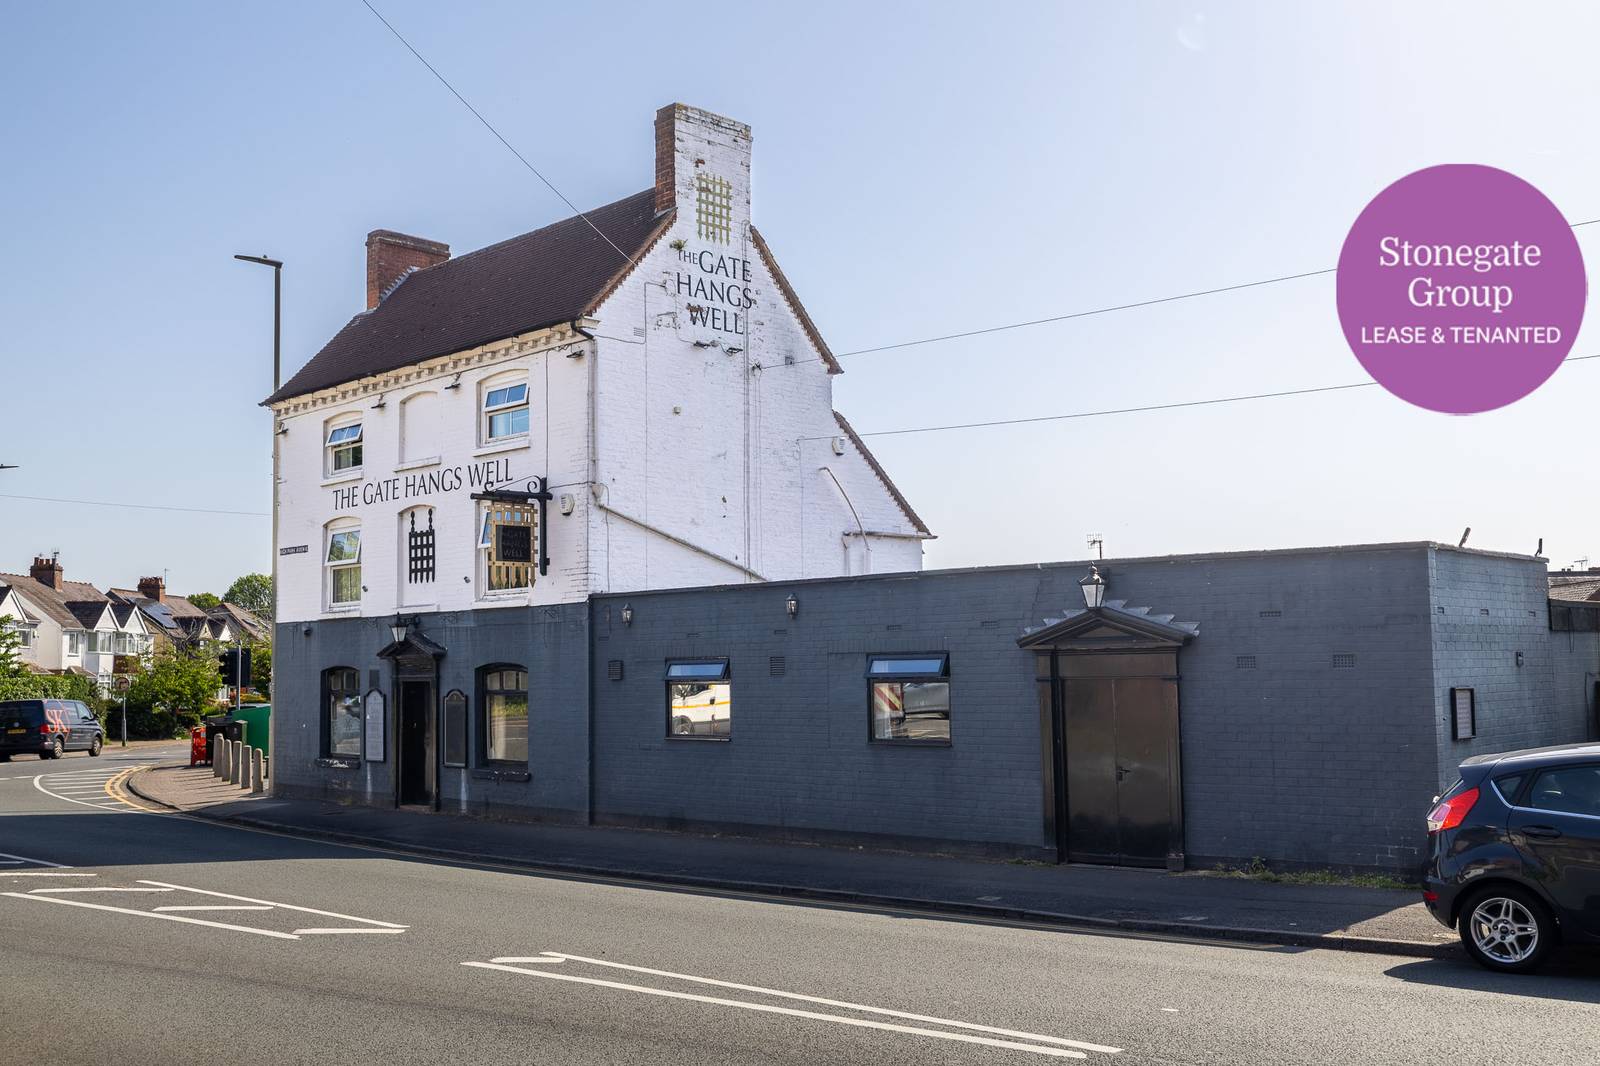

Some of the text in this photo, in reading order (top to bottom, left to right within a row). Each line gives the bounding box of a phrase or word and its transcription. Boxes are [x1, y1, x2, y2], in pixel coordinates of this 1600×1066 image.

[677, 250, 752, 283] THE GATE
[676, 272, 753, 310] HANGS
[687, 302, 744, 335] WELL
[332, 458, 513, 510] THE GATE HANGS WELL
